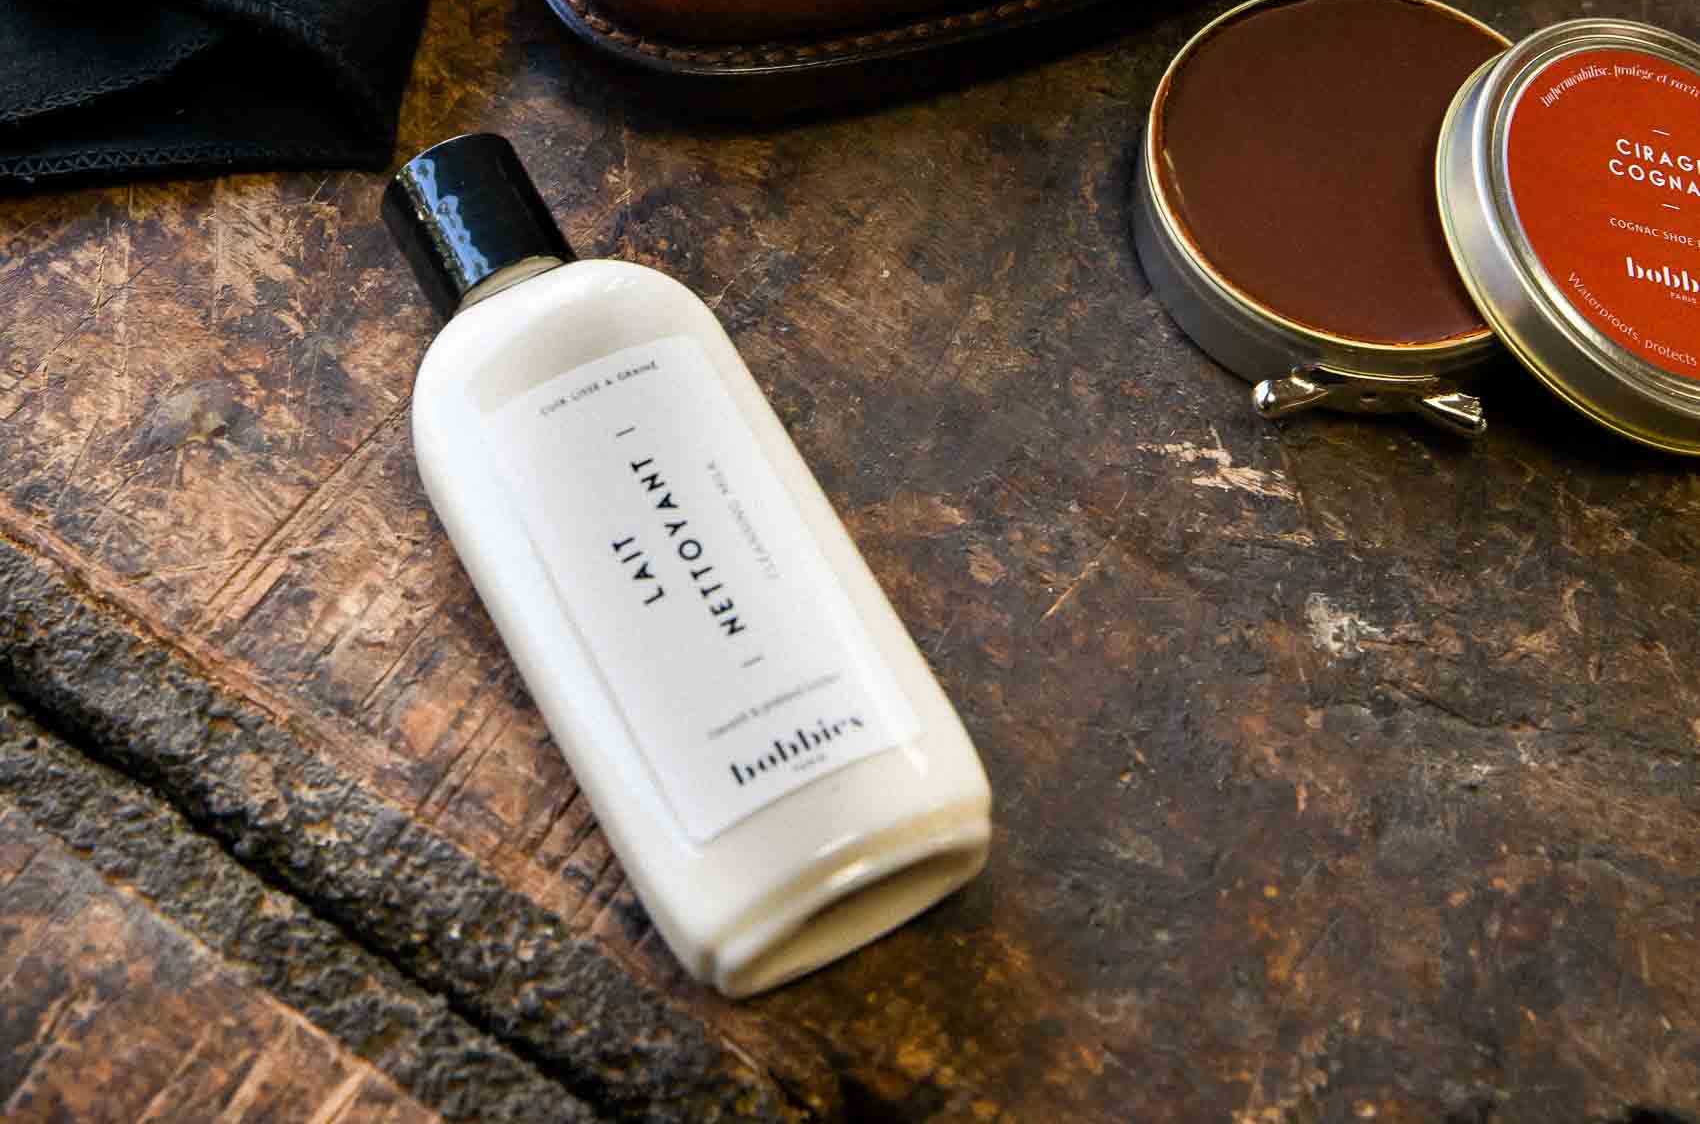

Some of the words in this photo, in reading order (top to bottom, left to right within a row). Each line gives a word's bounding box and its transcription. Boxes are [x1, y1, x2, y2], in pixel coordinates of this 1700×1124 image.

[1610, 217, 1659, 237] COGNAC
[1664, 232, 1694, 246] SHOE
[1645, 339, 1697, 366] protects
[612, 536, 665, 606] LAIT
[631, 457, 746, 636] NETTOYANT
[730, 716, 863, 786] bobbies
